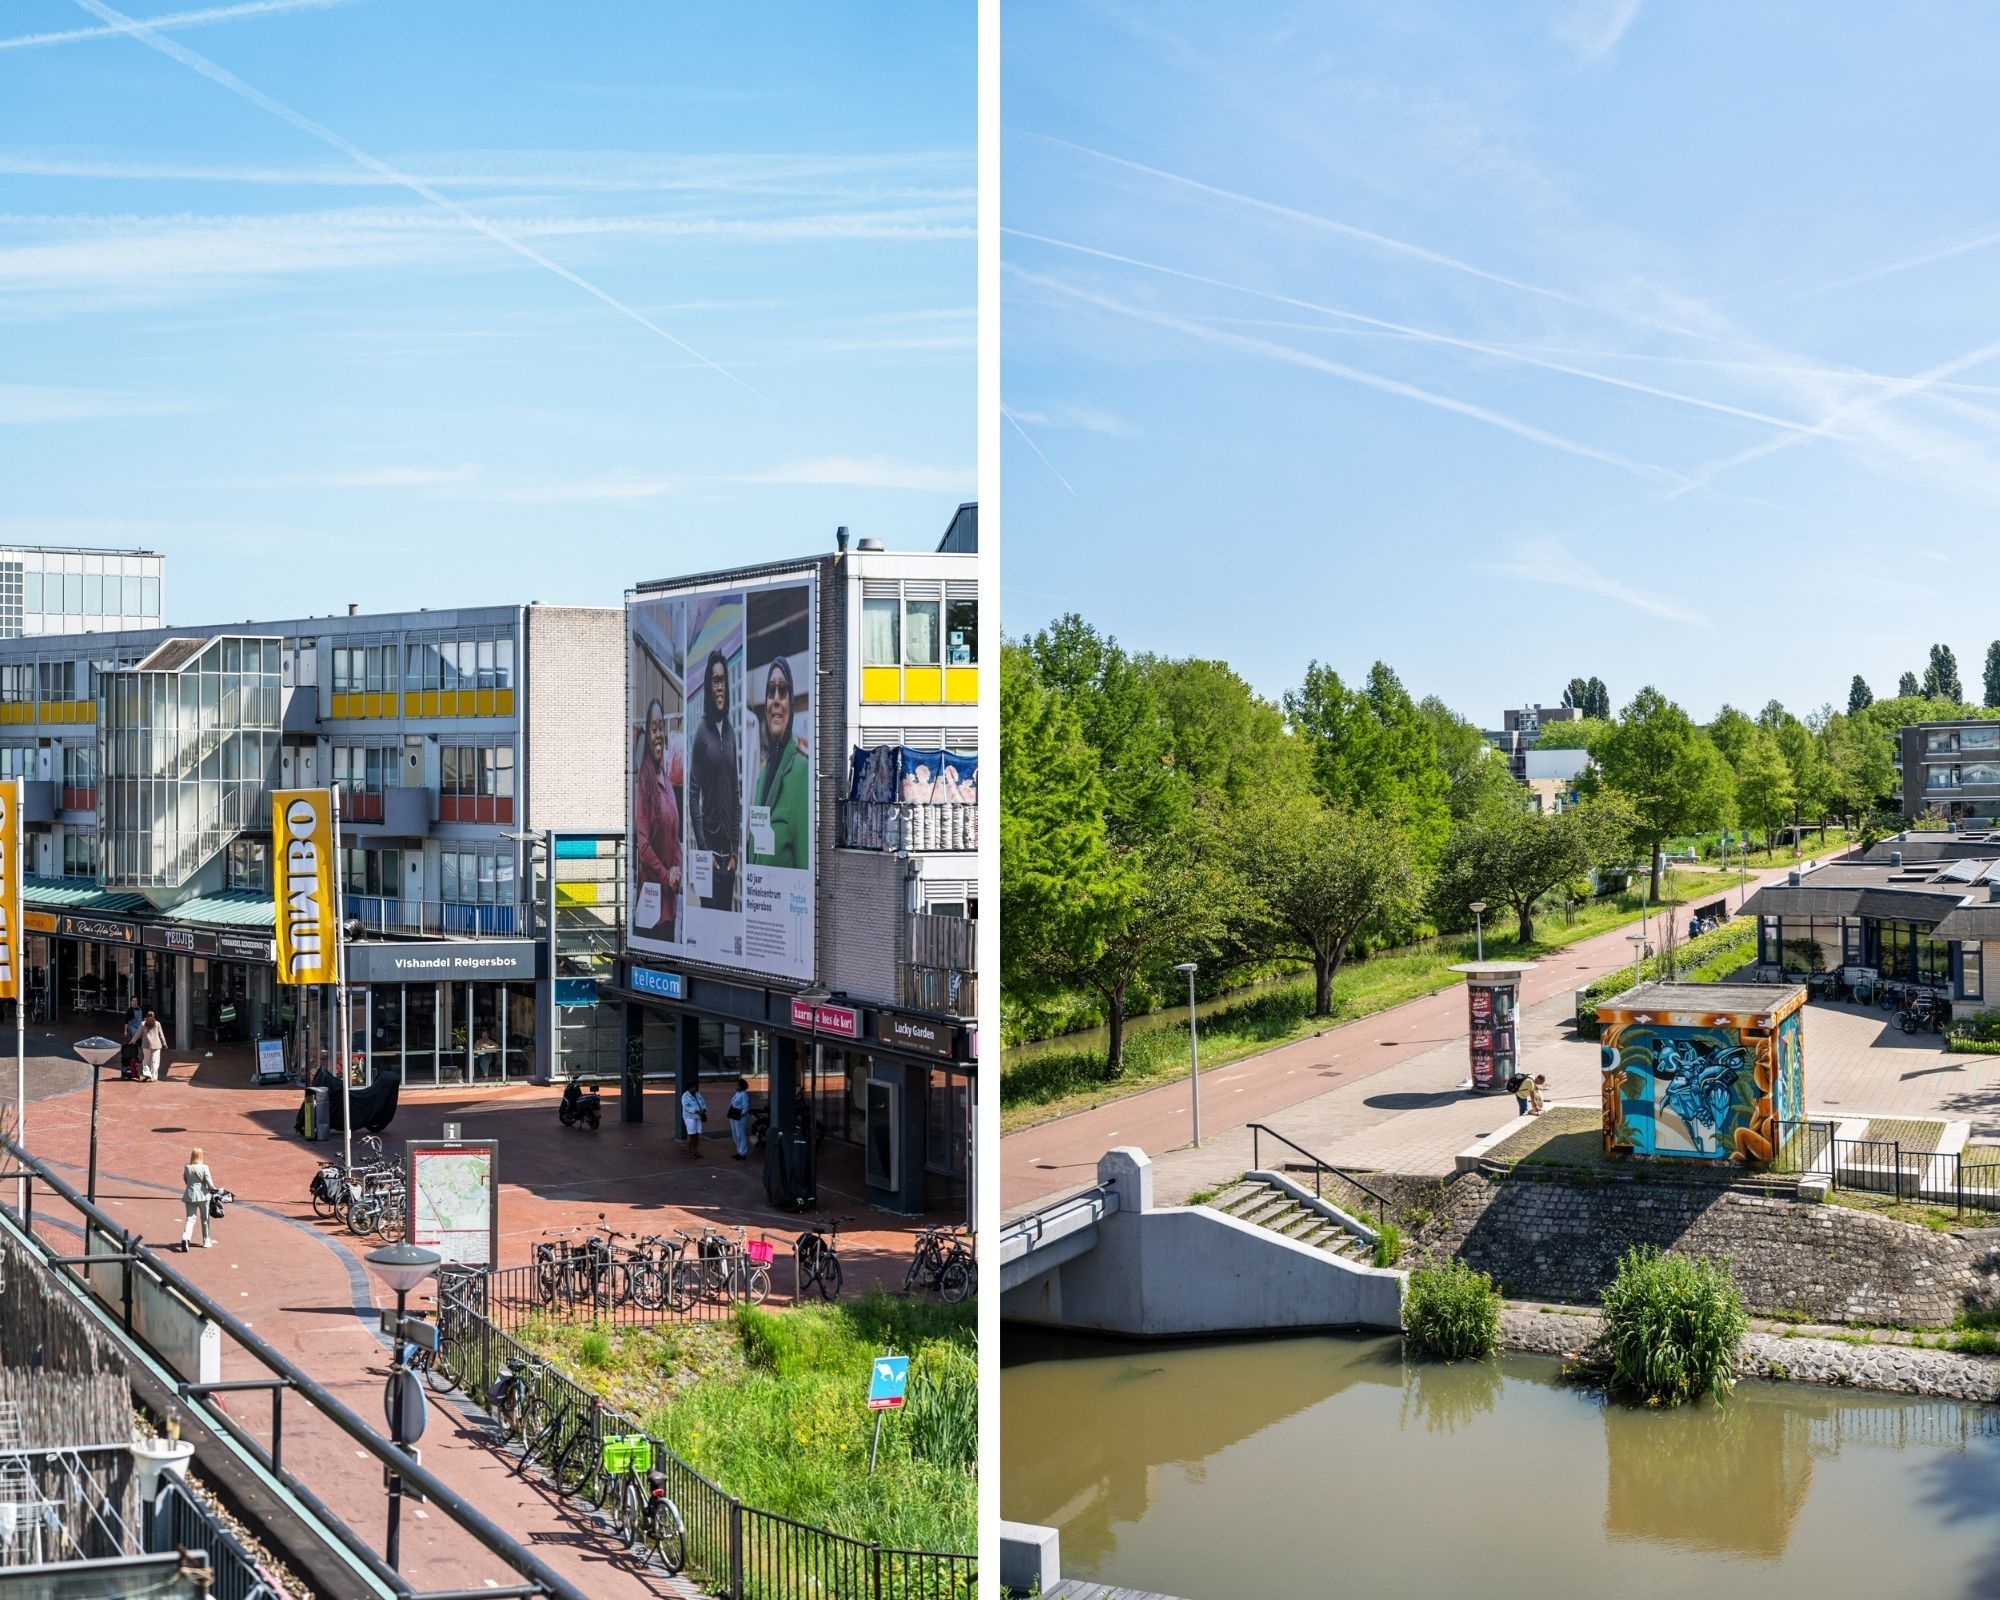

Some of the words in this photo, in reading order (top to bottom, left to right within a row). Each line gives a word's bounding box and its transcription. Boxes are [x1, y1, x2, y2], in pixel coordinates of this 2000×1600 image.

[746, 873, 753, 882] 40
[753, 873, 763, 885] jaar
[746, 886, 782, 900] Winkelcentrum
[746, 899, 772, 912] Reigersbos
[93, 923, 109, 937] Hair
[108, 924, 123, 937] Salon
[165, 931, 195, 950] TEUJIB
[395, 958, 450, 968] Vishandel
[454, 956, 517, 968] Reigersbos
[634, 970, 680, 994] telecom
[794, 1006, 820, 1023] haarme
[821, 1012, 833, 1025] loes
[833, 1013, 840, 1027] de
[840, 1015, 853, 1030] kort
[894, 1021, 912, 1038] Lucky
[912, 1025, 935, 1040] Garden
